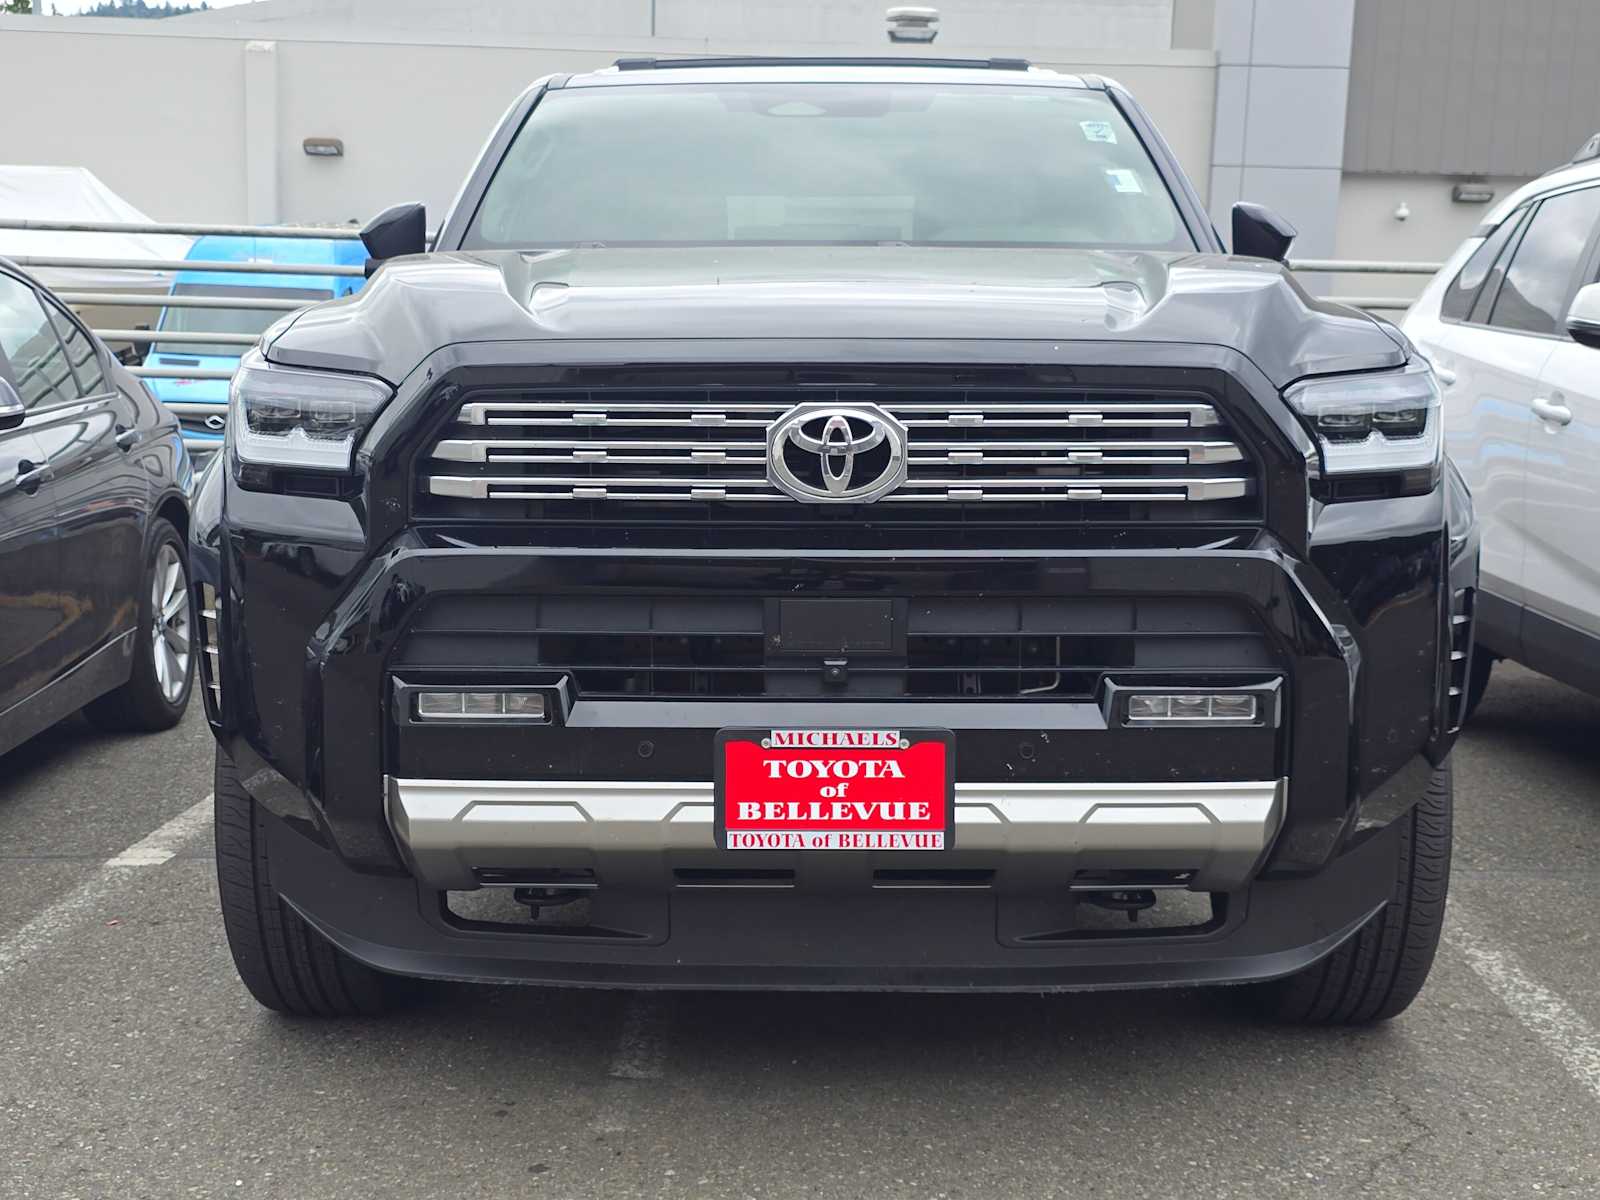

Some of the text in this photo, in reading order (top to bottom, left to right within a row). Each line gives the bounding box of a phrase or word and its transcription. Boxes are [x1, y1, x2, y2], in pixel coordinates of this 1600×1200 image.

[775, 732, 897, 745] MICHAELS
[763, 760, 905, 778] TOYOTA
[819, 783, 849, 797] of
[737, 802, 930, 820] BELLEVUE
[729, 833, 942, 848] TOYOTA of BELLEVUE
